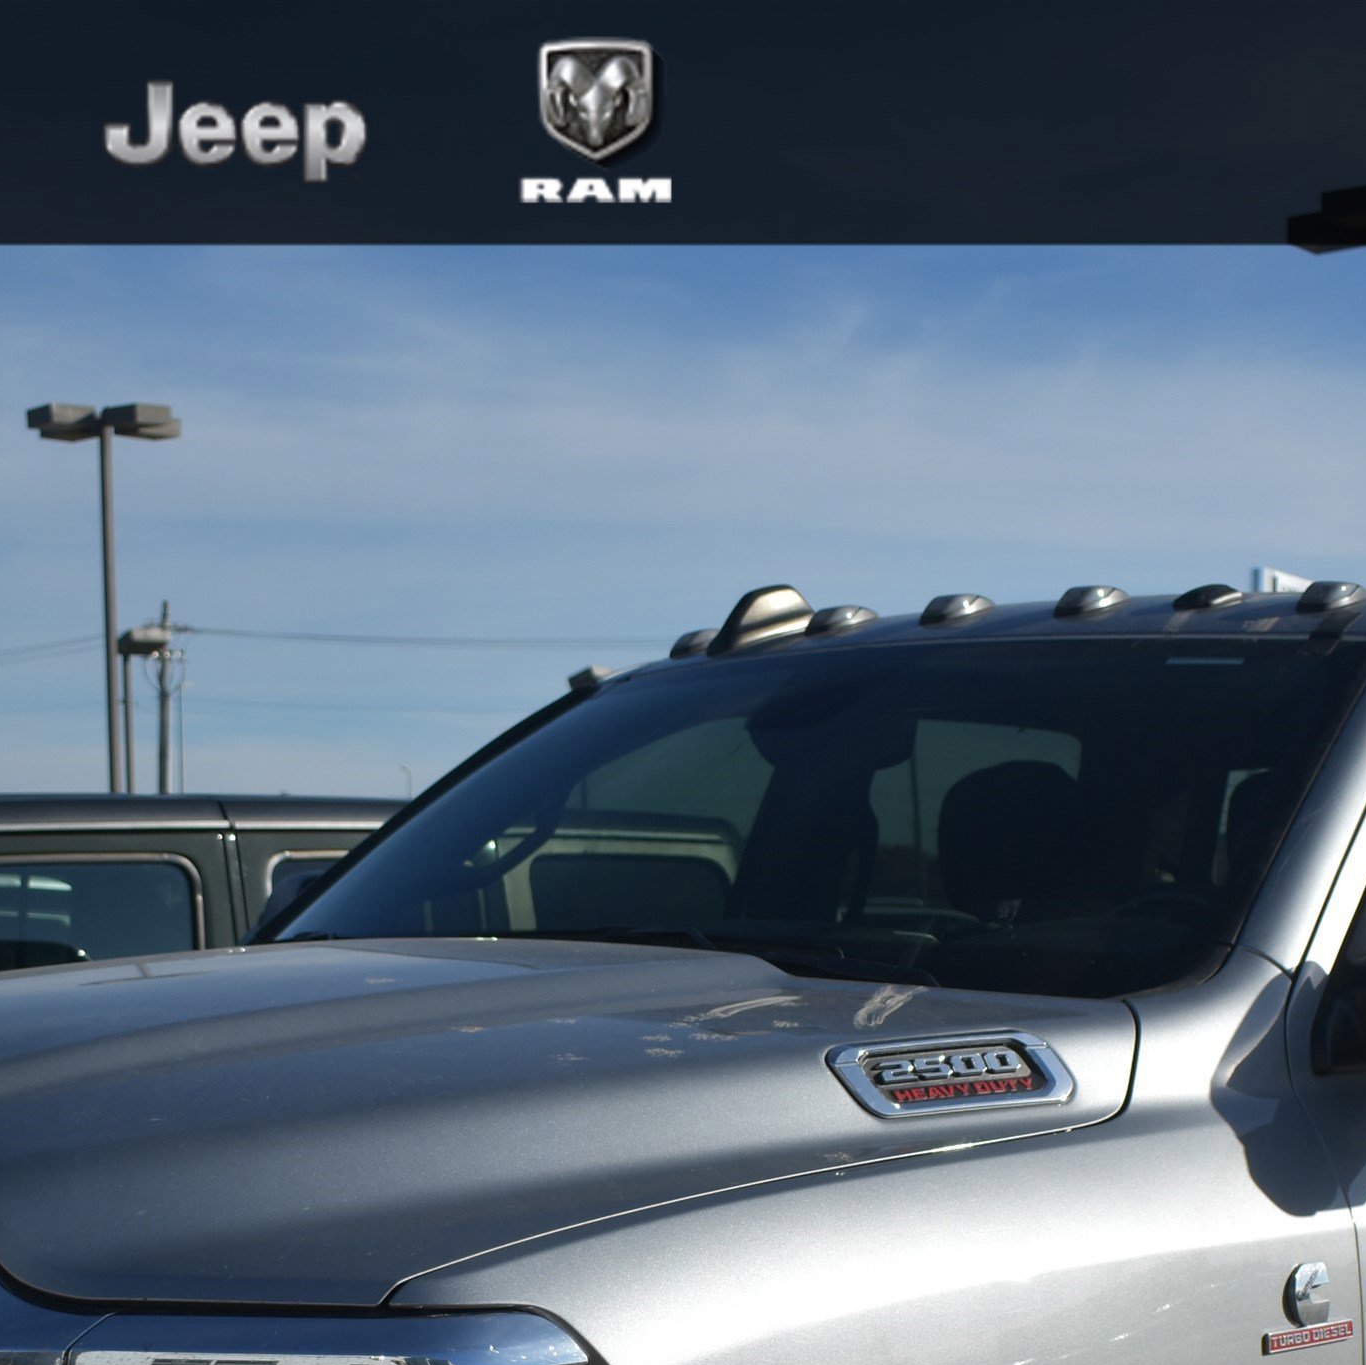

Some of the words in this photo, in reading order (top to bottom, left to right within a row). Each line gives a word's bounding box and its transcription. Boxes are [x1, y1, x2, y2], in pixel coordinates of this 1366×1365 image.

[875, 1049, 1023, 1084] 2500
[895, 1084, 970, 1103] HEAVY
[973, 1077, 1034, 1096] DUTY
[1271, 1331, 1311, 1348] TURBO
[1313, 1324, 1352, 1340] DIESEL
